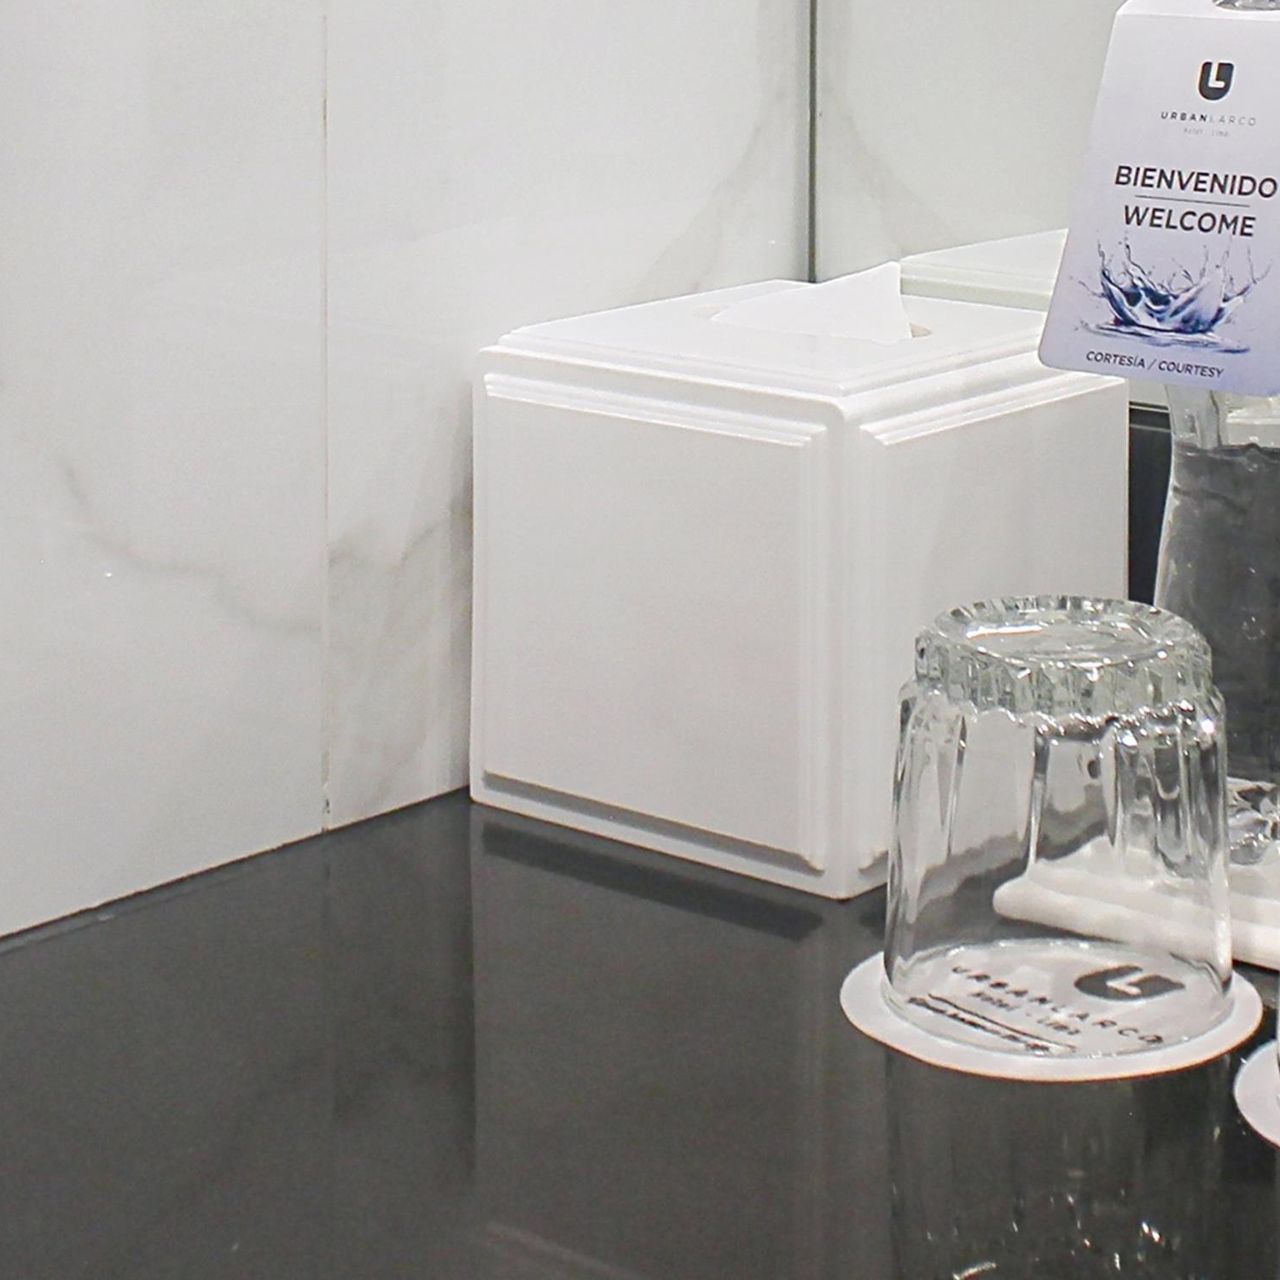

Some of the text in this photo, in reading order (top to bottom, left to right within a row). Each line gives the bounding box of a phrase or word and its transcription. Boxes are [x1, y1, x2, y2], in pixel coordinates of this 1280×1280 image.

[1114, 165, 1278, 198] BIENVENIDO
[1124, 205, 1256, 237] WELCOME
[1086, 351, 1146, 369] CORTESÍA
[1158, 360, 1224, 378] COURTESY
